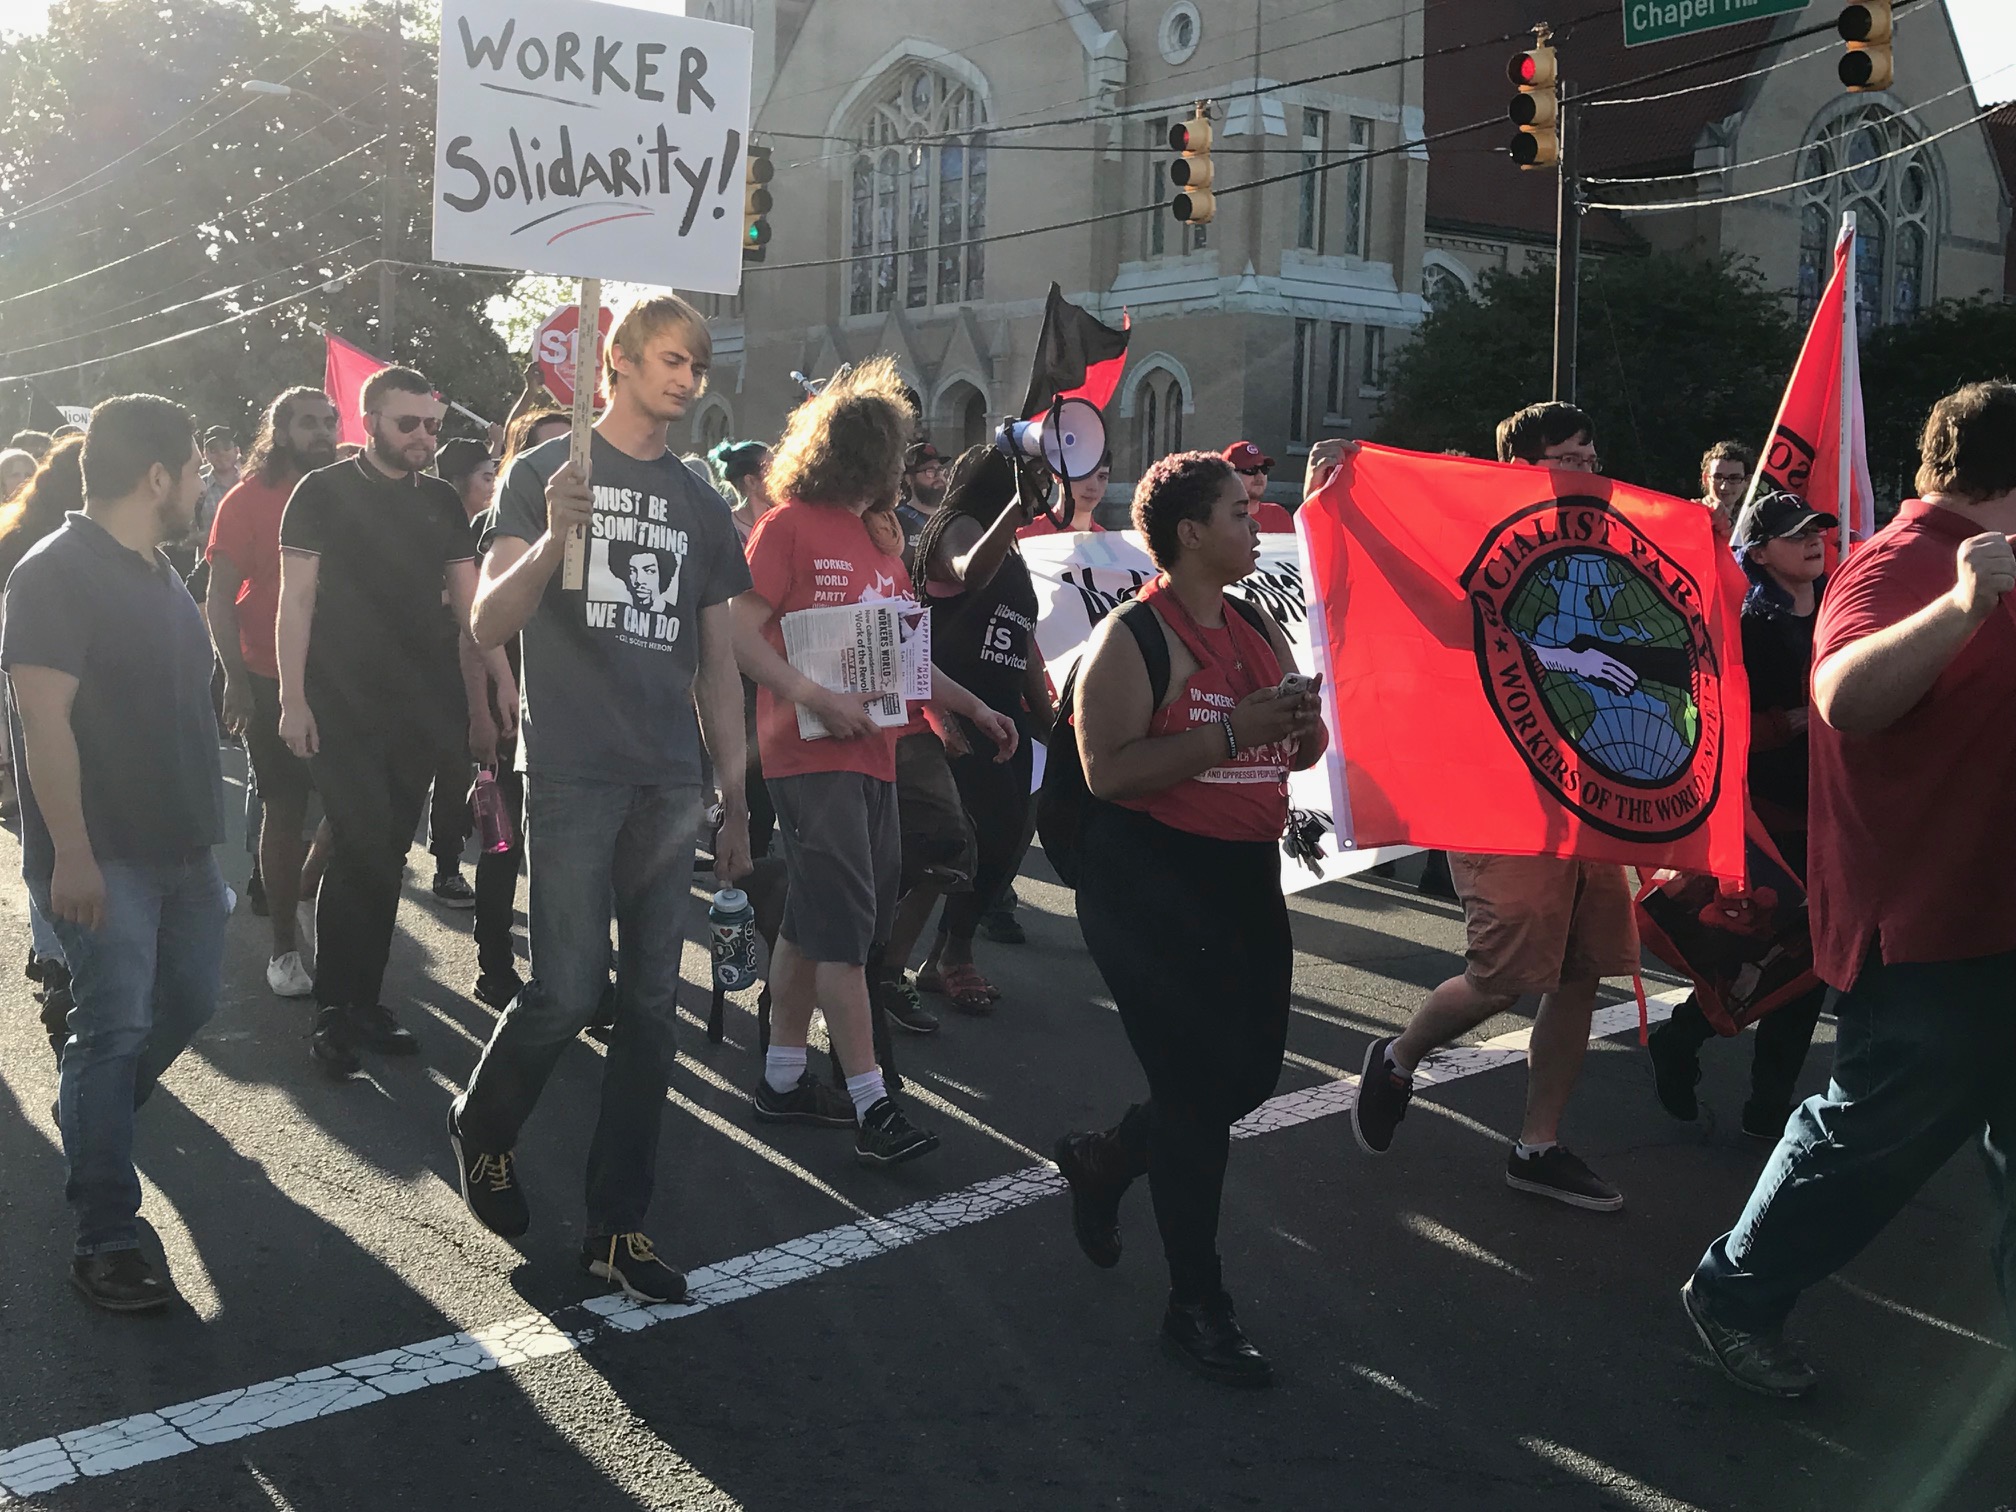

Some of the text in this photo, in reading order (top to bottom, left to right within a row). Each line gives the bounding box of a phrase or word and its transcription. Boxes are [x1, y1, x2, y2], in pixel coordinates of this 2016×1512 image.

[1632, 0, 1714, 31] Chapel
[457, 15, 716, 115] WORKER
[592, 485, 668, 522] MUST BE
[813, 558, 854, 572] WORKERS
[815, 574, 849, 587] WORLD
[814, 590, 847, 602] PARTY
[1629, 537, 1713, 667] PARTY
[586, 602, 681, 643] WE CAN DO
[984, 617, 1012, 650] is
[856, 639, 866, 648] of
[857, 649, 867, 665] the
[877, 608, 891, 677] WORKERS WORLD
[1498, 661, 1581, 792] WORKERS
[1582, 780, 1613, 811] OF
[1615, 793, 1654, 824] THE
[1654, 774, 1706, 822] WORLD
[1207, 770, 1221, 779] AND
[1222, 769, 1256, 779] OPPRESSED
